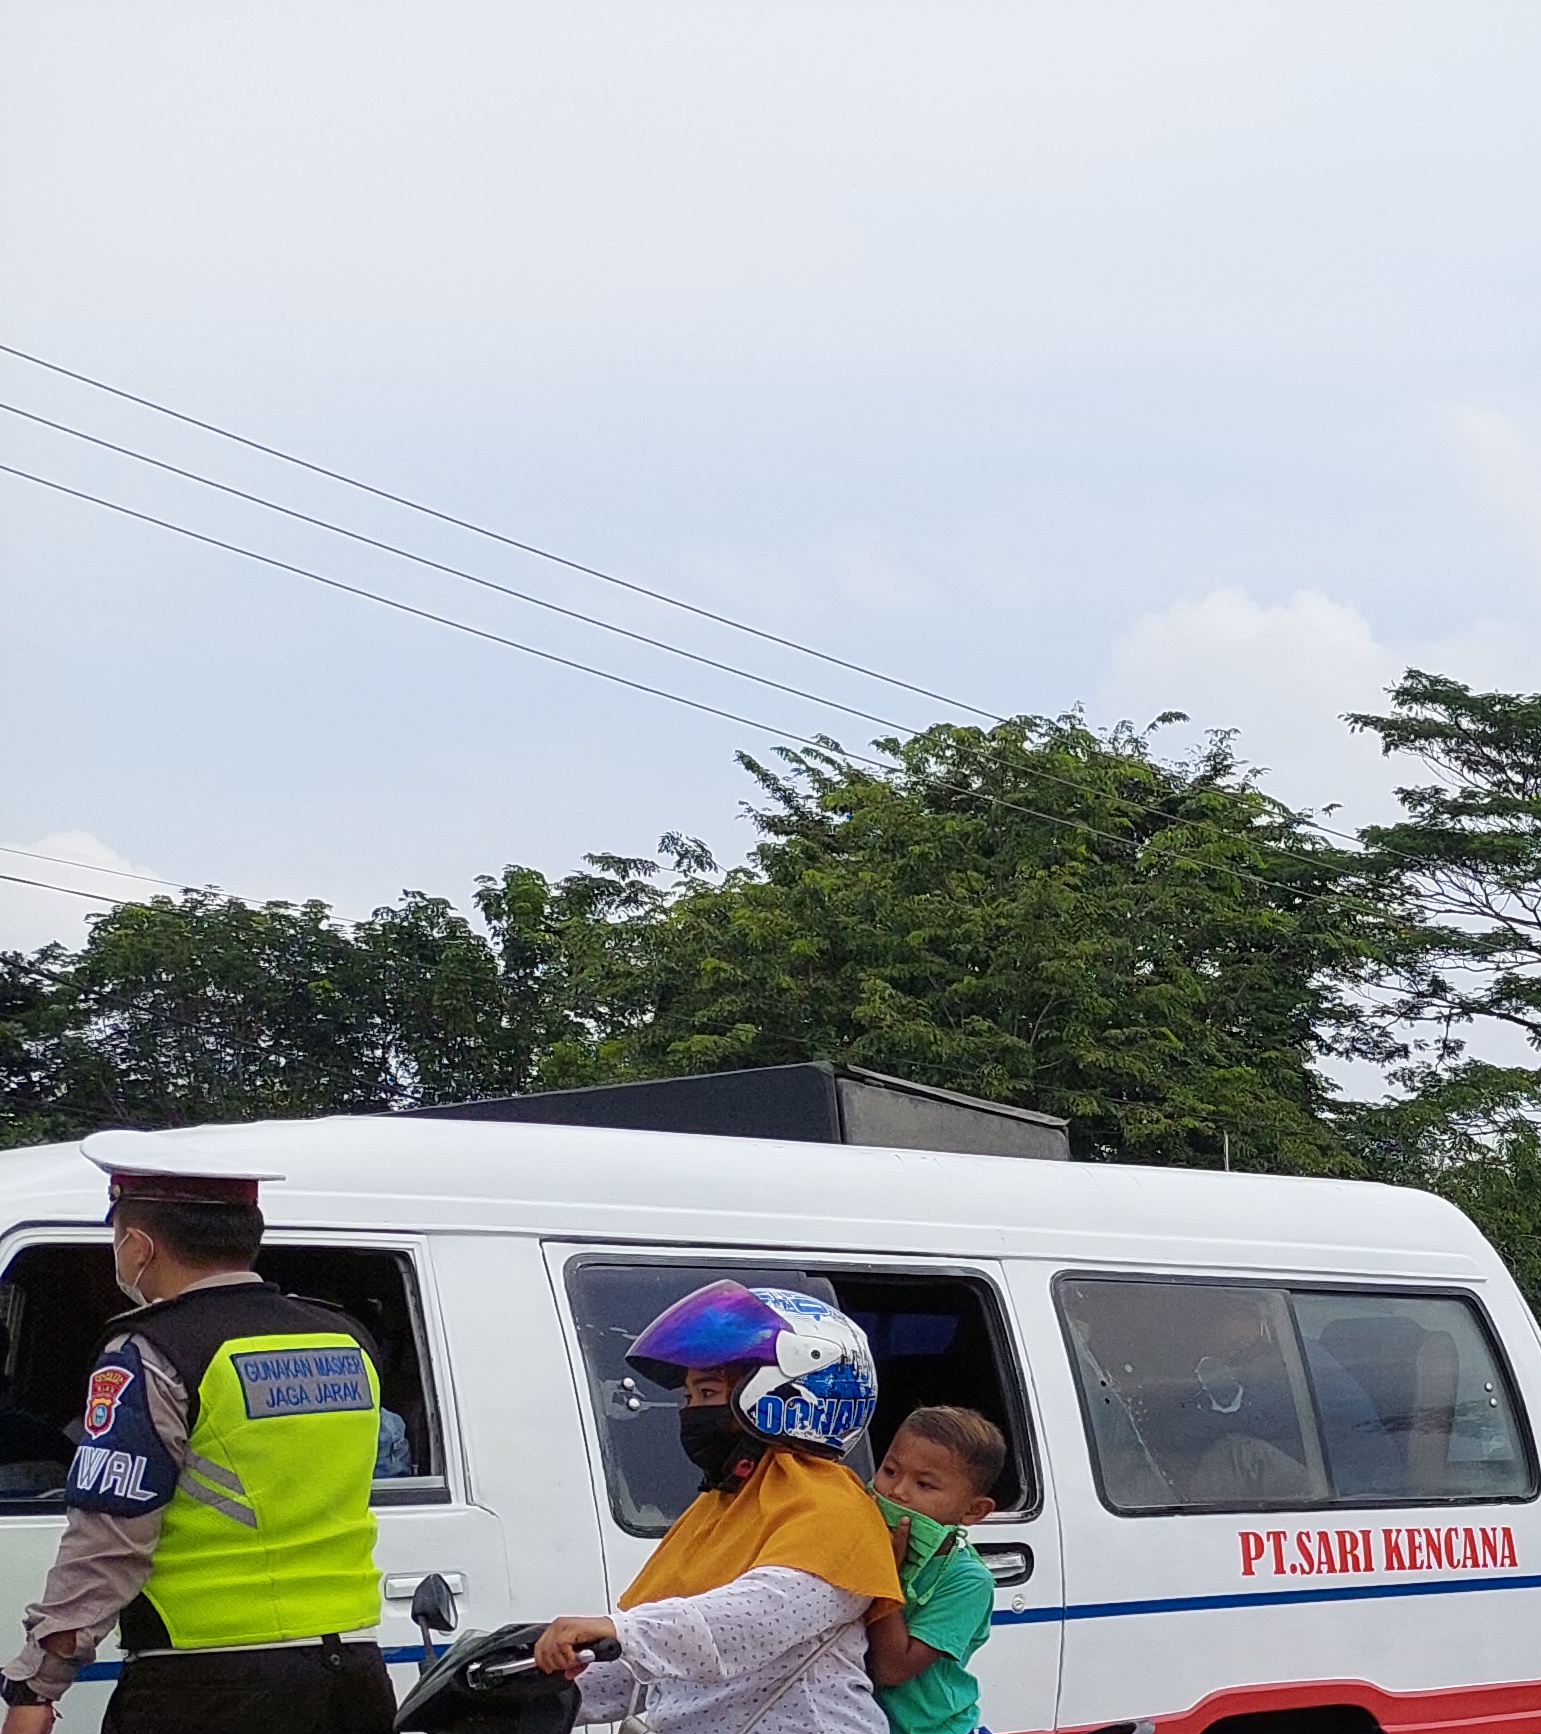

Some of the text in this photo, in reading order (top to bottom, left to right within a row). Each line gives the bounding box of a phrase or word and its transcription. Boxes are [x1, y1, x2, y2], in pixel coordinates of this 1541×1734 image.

[243, 1355, 363, 1382] GUNAKAN MASKER
[266, 1382, 362, 1408] JAGA JARAK
[67, 1446, 159, 1501] WAL
[1238, 1526, 1519, 1576] PT.SARI KENCANA
